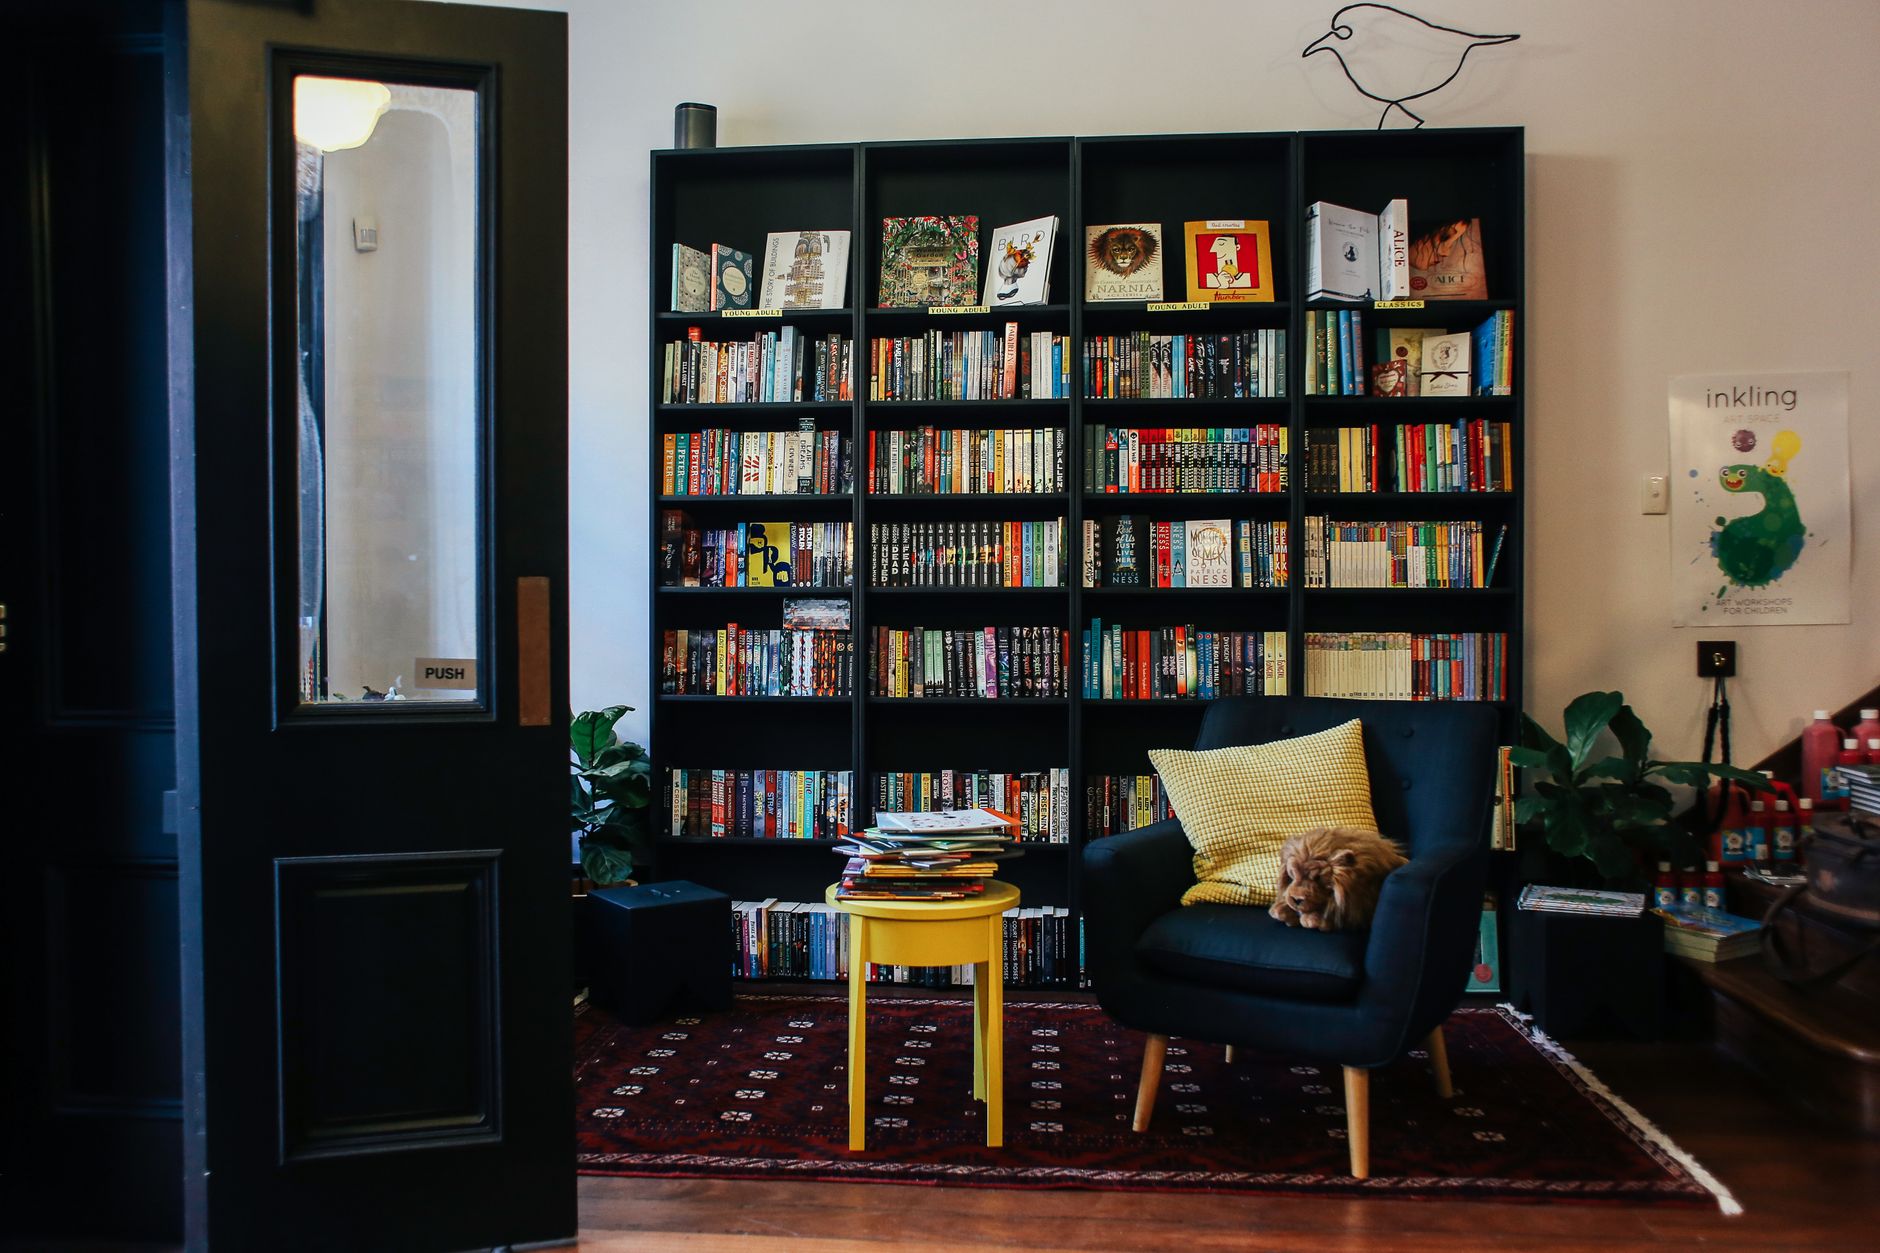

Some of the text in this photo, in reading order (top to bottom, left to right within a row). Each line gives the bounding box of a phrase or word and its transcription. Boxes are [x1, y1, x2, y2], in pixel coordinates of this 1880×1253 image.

[998, 230, 1045, 251] BIRD
[770, 237, 780, 269] BUILDINGS
[769, 270, 775, 280] OF
[766, 280, 774, 296] STORY
[1097, 284, 1154, 293] NARNIA
[1214, 290, 1245, 301] Numbers
[701, 345, 707, 353] ME
[719, 354, 727, 401] STARCROSSED
[1707, 386, 1798, 411] inkling
[1723, 414, 1780, 424] ART SPACE
[1191, 575, 1227, 584] NESS
[1734, 598, 1792, 607] WORKSHOPS
[1033, 656, 1041, 675] spirit
[425, 667, 465, 680] PUSH
